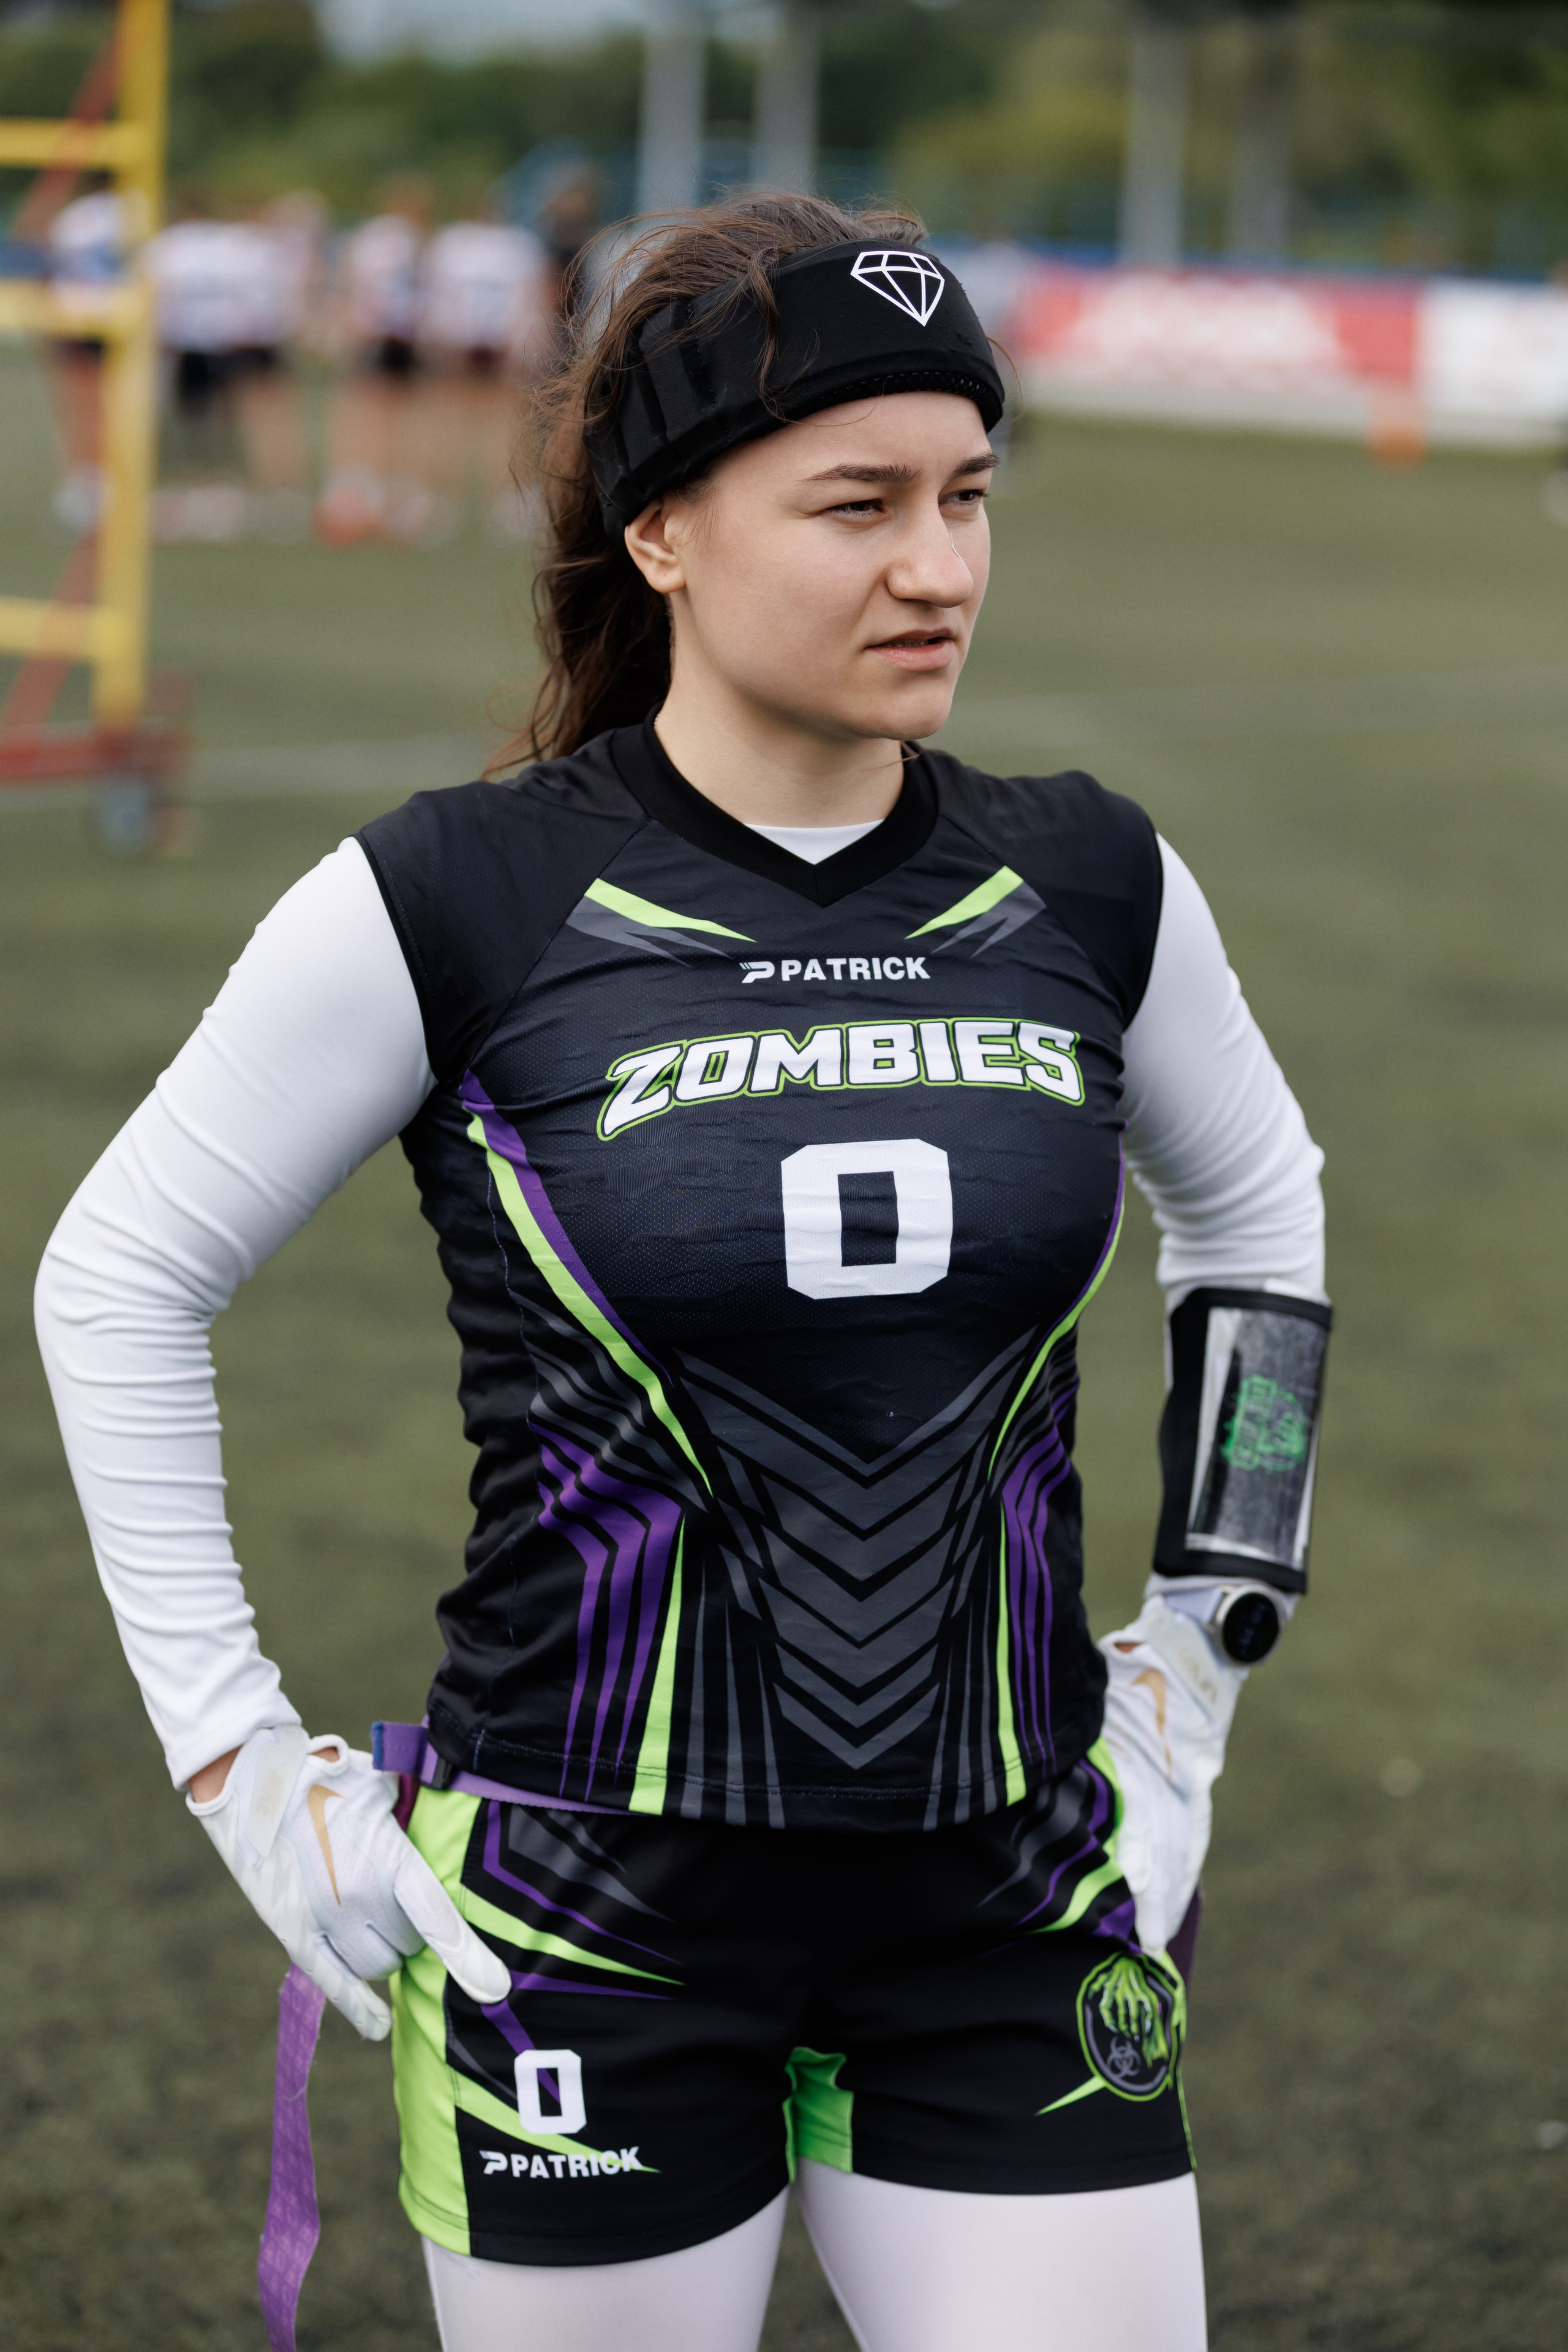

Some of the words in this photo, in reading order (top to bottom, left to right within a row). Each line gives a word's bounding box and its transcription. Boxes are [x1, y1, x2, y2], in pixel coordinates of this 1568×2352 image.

[781, 957, 931, 981] PATRICK
[597, 1017, 1085, 1141] ZOMBIES
[781, 1138, 953, 1300] 0
[514, 2049, 587, 2134] 0
[510, 2146, 643, 2178] PATRICK
